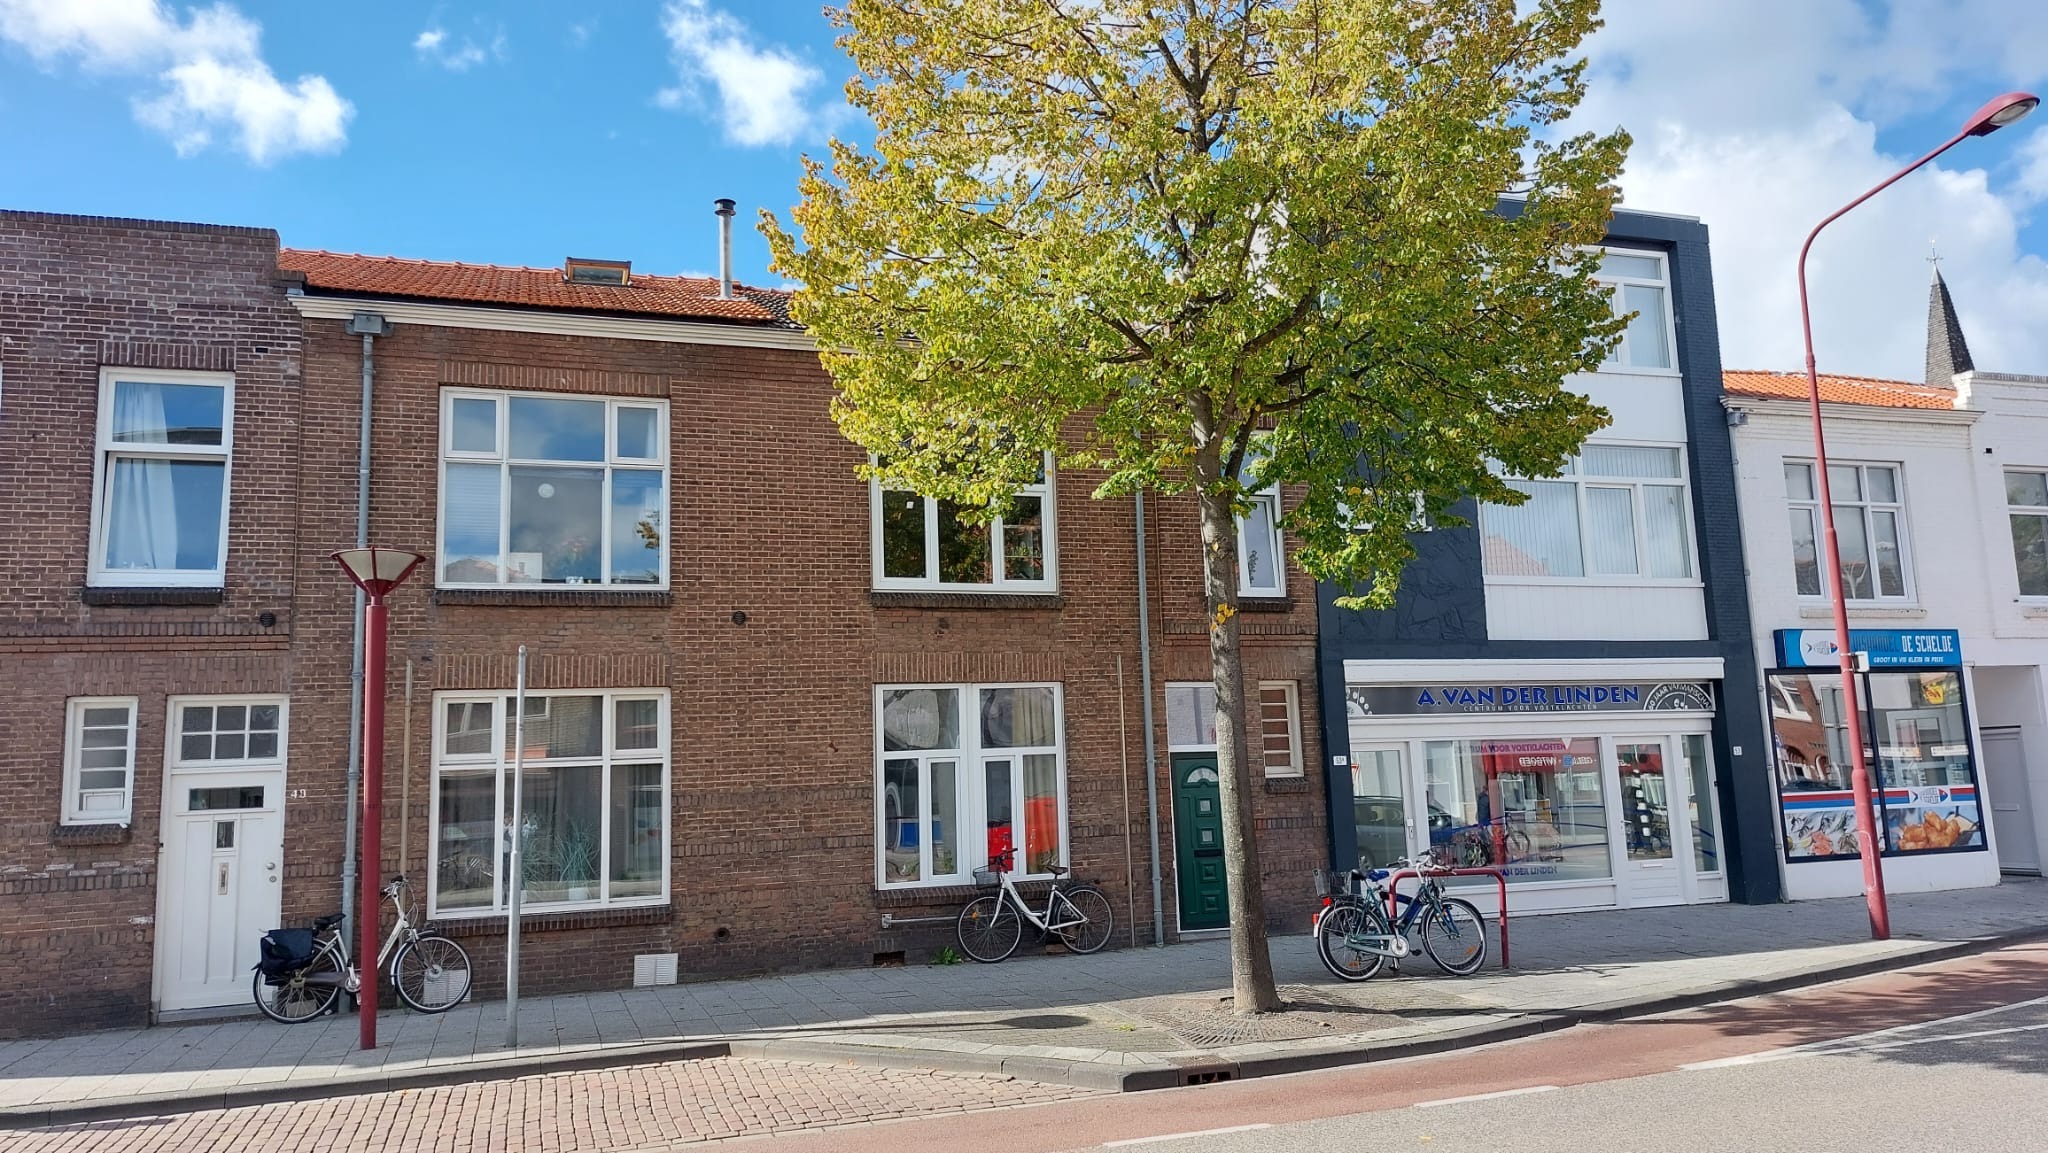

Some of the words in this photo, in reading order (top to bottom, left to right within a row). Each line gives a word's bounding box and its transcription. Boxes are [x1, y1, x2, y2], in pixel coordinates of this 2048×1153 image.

[1901, 635, 1913, 653] DE
[1914, 635, 1953, 653] SCHELDE
[1502, 686, 1549, 706] DER
[1553, 685, 1640, 705] LINDEN
[1463, 704, 1503, 712] CENTRUM
[1507, 704, 1530, 712] VOOR
[1534, 703, 1598, 712] VOETKLACHTEN
